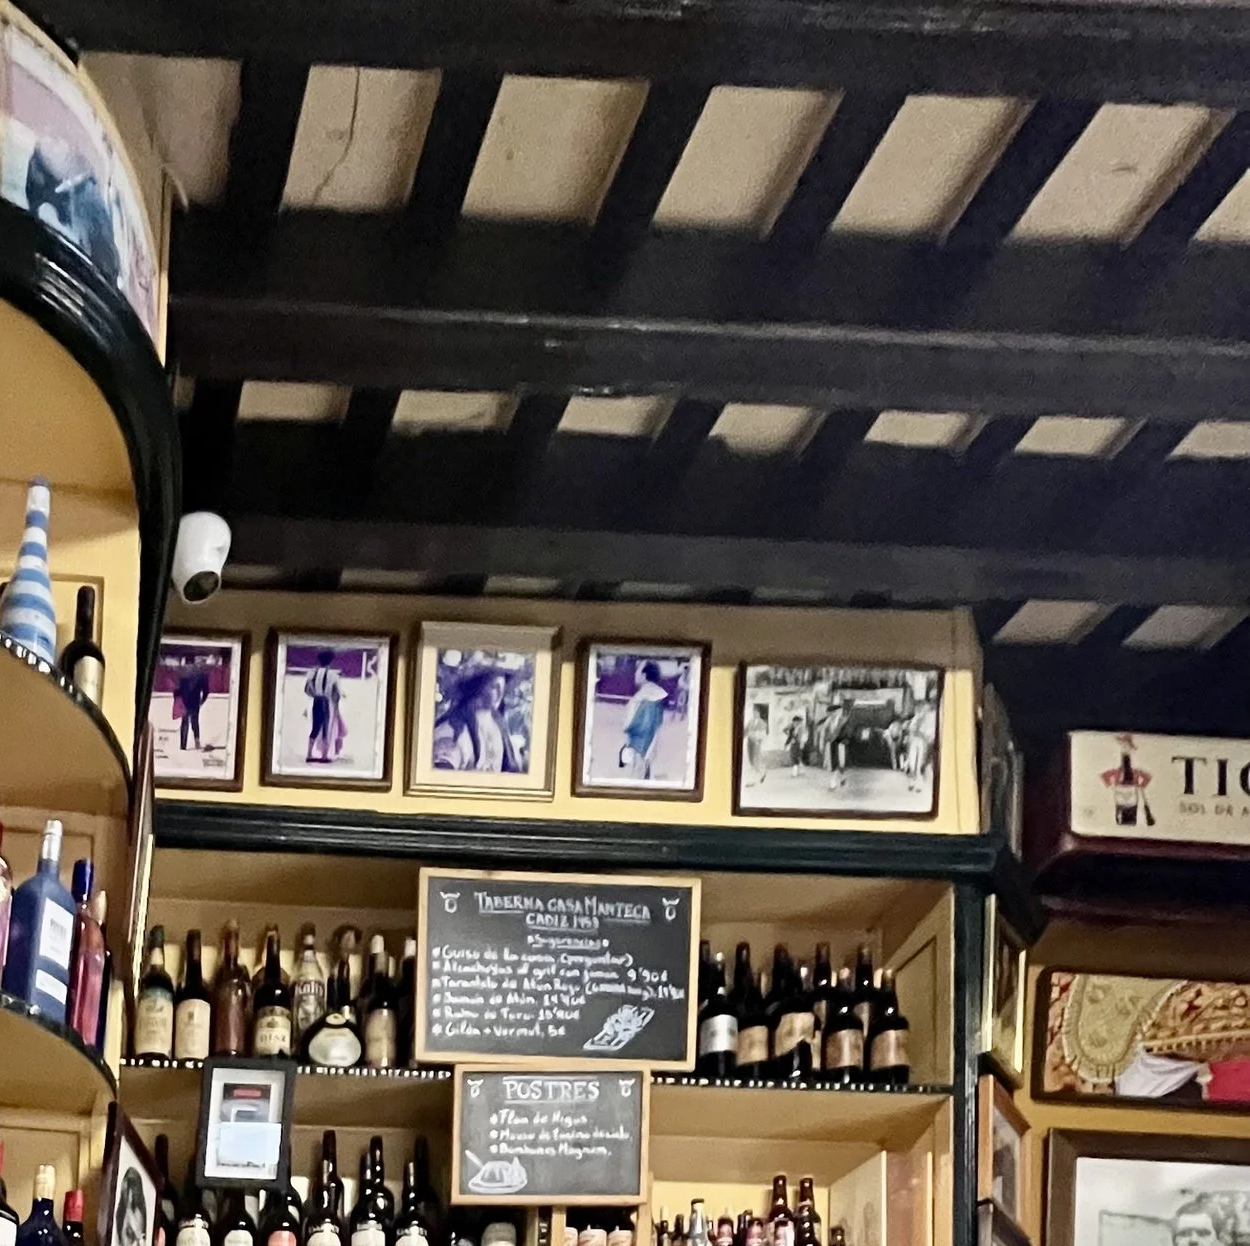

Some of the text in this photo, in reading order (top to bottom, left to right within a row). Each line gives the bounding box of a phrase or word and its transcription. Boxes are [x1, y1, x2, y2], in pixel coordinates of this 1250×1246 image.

[474, 891, 651, 920] TABERNA CASA MANTECA
[503, 1080, 600, 1100] POSTRES
[499, 1108, 529, 1125] Flan
